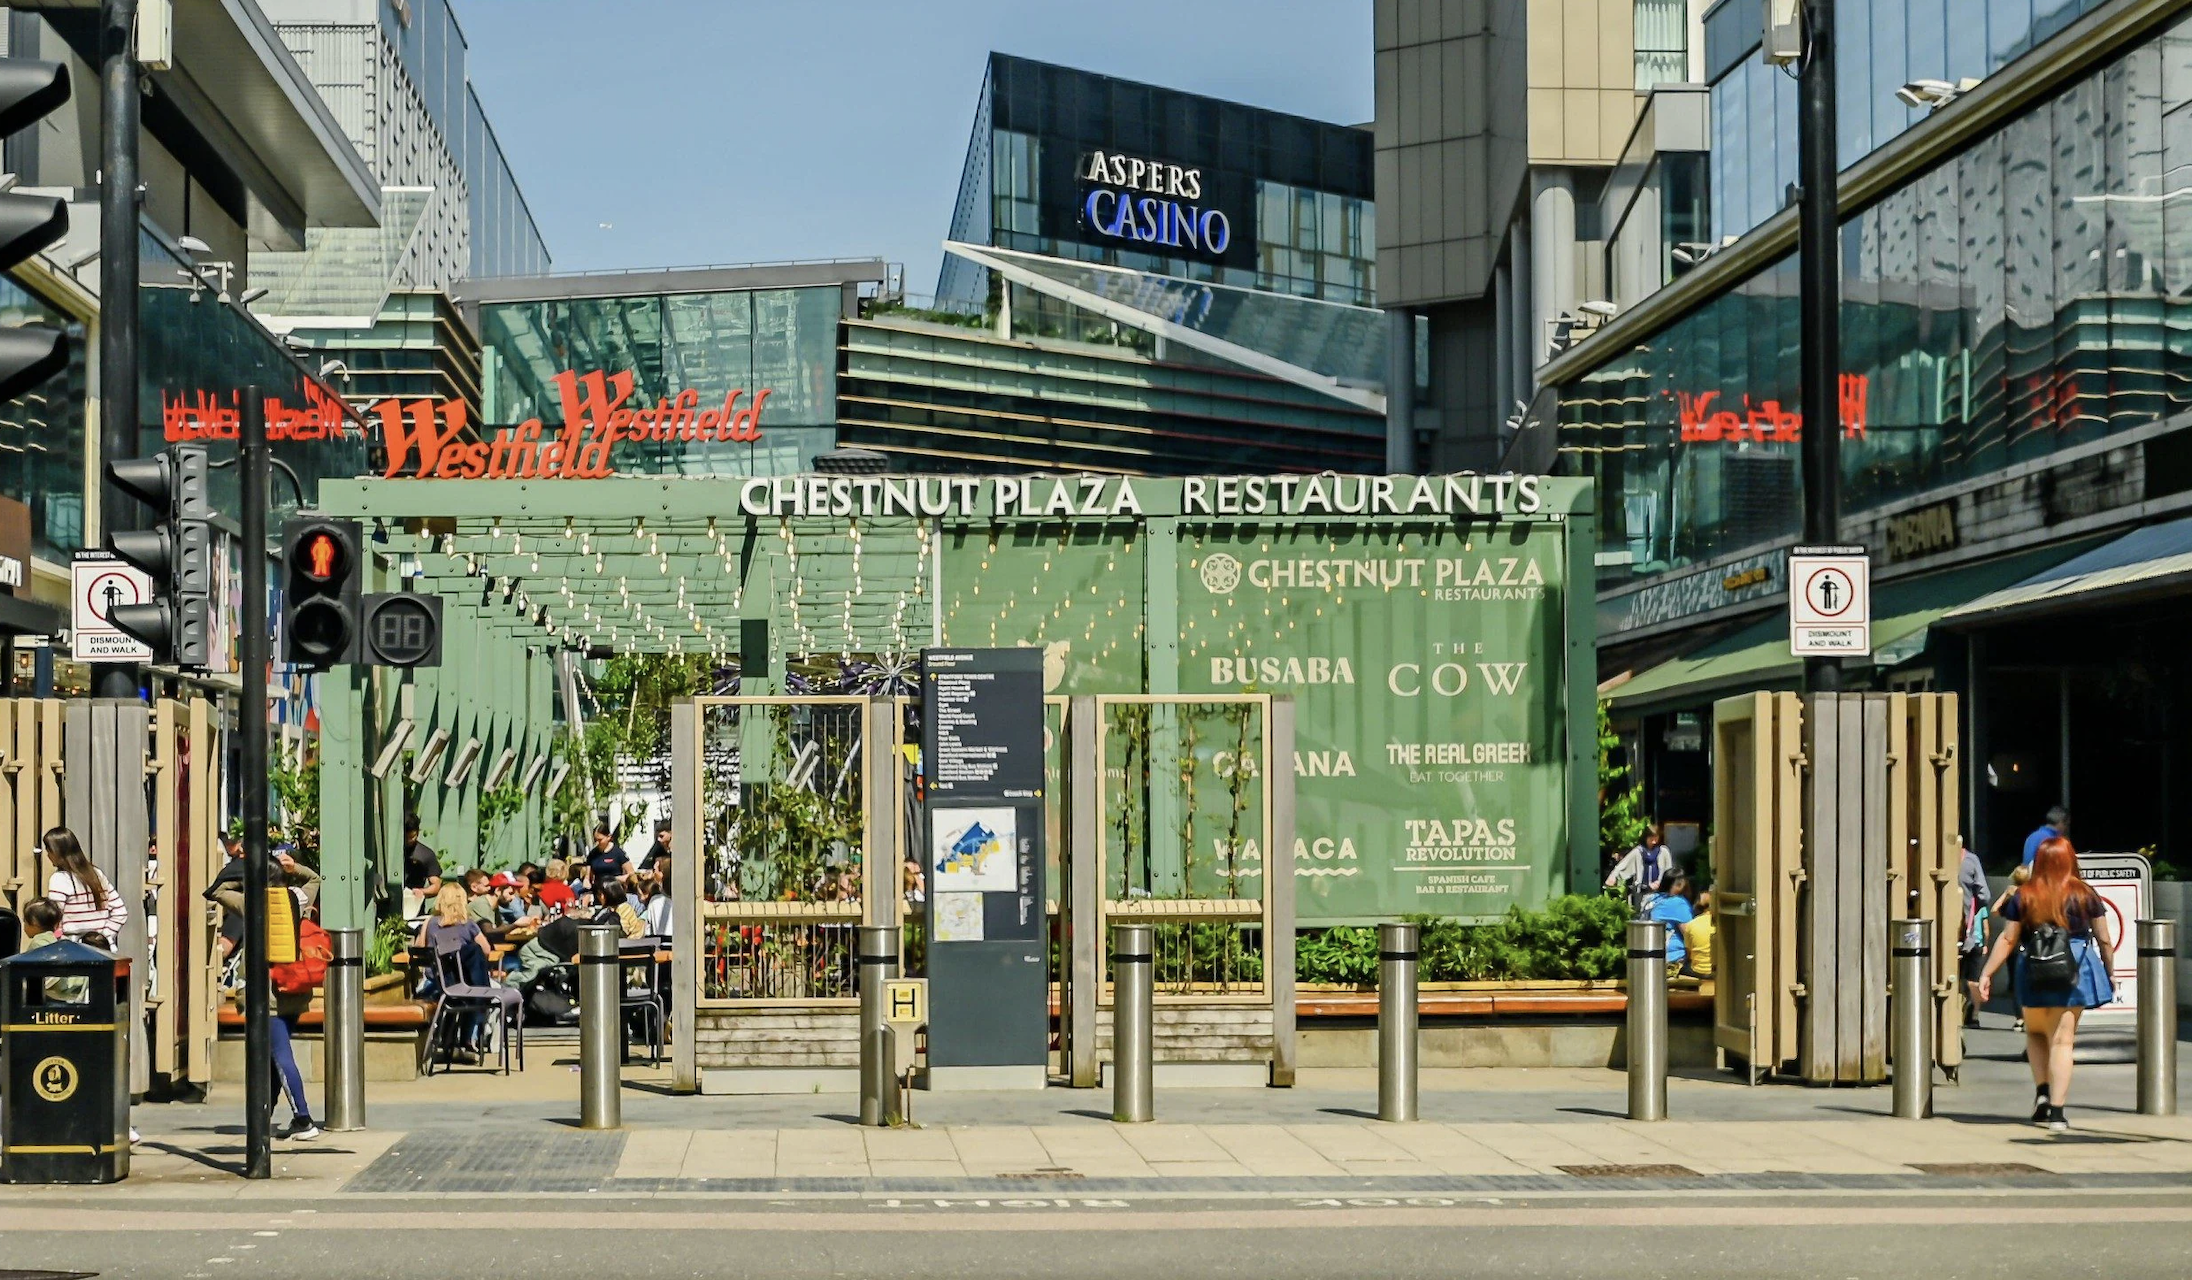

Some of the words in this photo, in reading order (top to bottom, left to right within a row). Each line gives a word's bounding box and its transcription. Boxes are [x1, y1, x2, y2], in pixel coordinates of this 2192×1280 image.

[1084, 151, 1200, 199] ASPERS
[1086, 190, 1230, 254] CASINO
[551, 369, 771, 442] Westfield
[372, 399, 614, 479] Westfield
[740, 478, 980, 516] CHESTNUT
[995, 478, 1142, 516] PLAZA
[1183, 475, 1541, 514] RESTAURANTS
[1250, 558, 1425, 588] CHESTNUT
[1435, 557, 1545, 587] PLAZA
[1434, 586, 1545, 601] RESTAURANTS
[1808, 630, 1852, 638] DISMOUNT
[90, 646, 109, 654] AND
[111, 646, 137, 654] WALK
[1432, 642, 1484, 655] THE
[1210, 657, 1355, 685] BUSABA
[1388, 662, 1528, 697] COW
[1212, 751, 1356, 778] CAANA
[1386, 743, 1421, 765] THE
[1424, 743, 1471, 765] REAL
[1473, 743, 1531, 764] GREEK
[1405, 819, 1516, 847] TAPAS
[1213, 837, 1358, 861] WAACA
[1405, 847, 1516, 862] REVOLUTION
[1428, 875, 1469, 884] SPANISH
[2087, 870, 2095, 879] OF
[2095, 869, 2116, 879] PUBLIC
[2116, 869, 2137, 878] SAFETY
[1416, 885, 1435, 894] BAR
[1437, 885, 1444, 894] &
[1445, 885, 1509, 894] RESTAURANT
[36, 1012, 75, 1024] Litter
